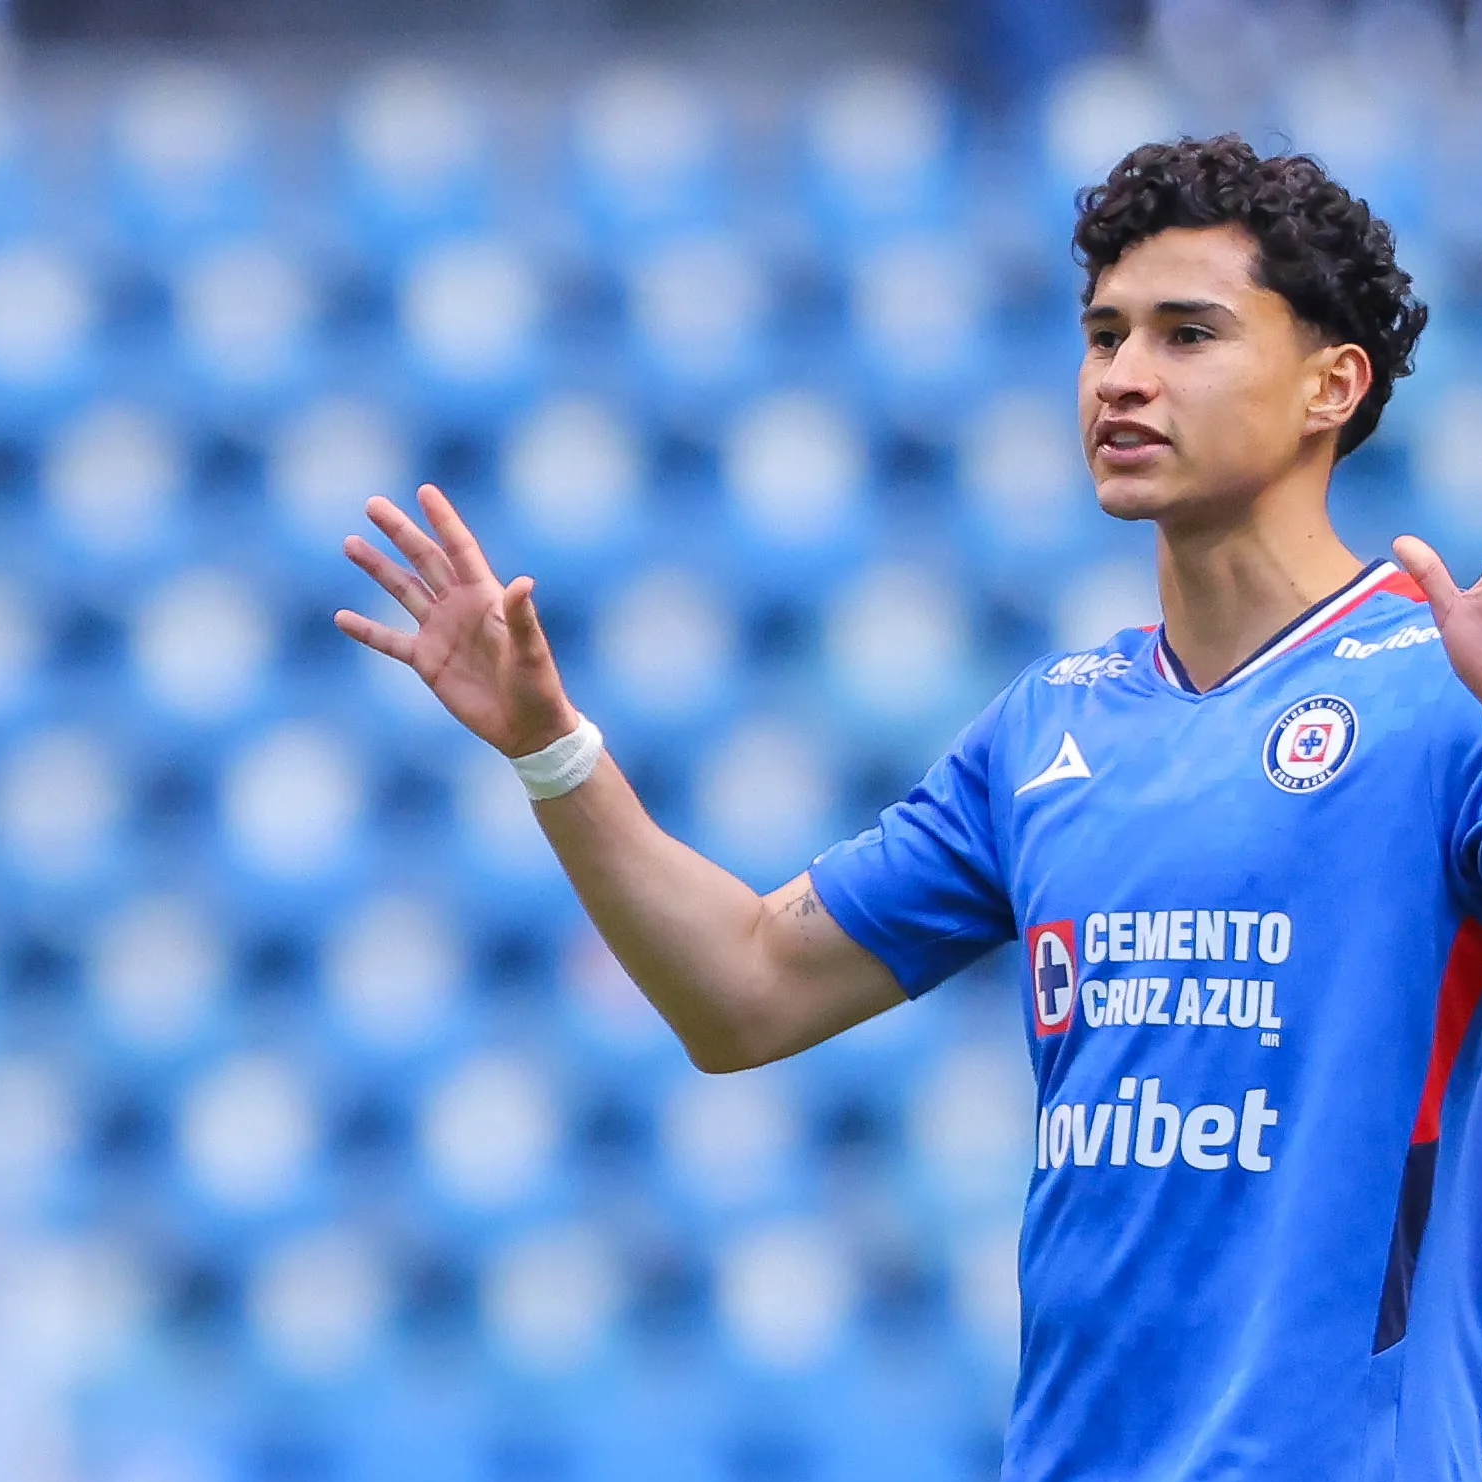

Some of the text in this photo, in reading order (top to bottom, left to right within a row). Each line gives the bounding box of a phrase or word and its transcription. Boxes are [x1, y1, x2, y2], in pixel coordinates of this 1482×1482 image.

[1333, 624, 1441, 659] novibe
[1279, 706, 1305, 729] CLUB
[1309, 700, 1323, 709] DE
[1272, 768, 1333, 789] CRUZ AZUL
[1084, 909, 1292, 965] CEMENTO
[1081, 977, 1282, 1030] CRUZ AZUL
[1260, 1032, 1281, 1048] MR
